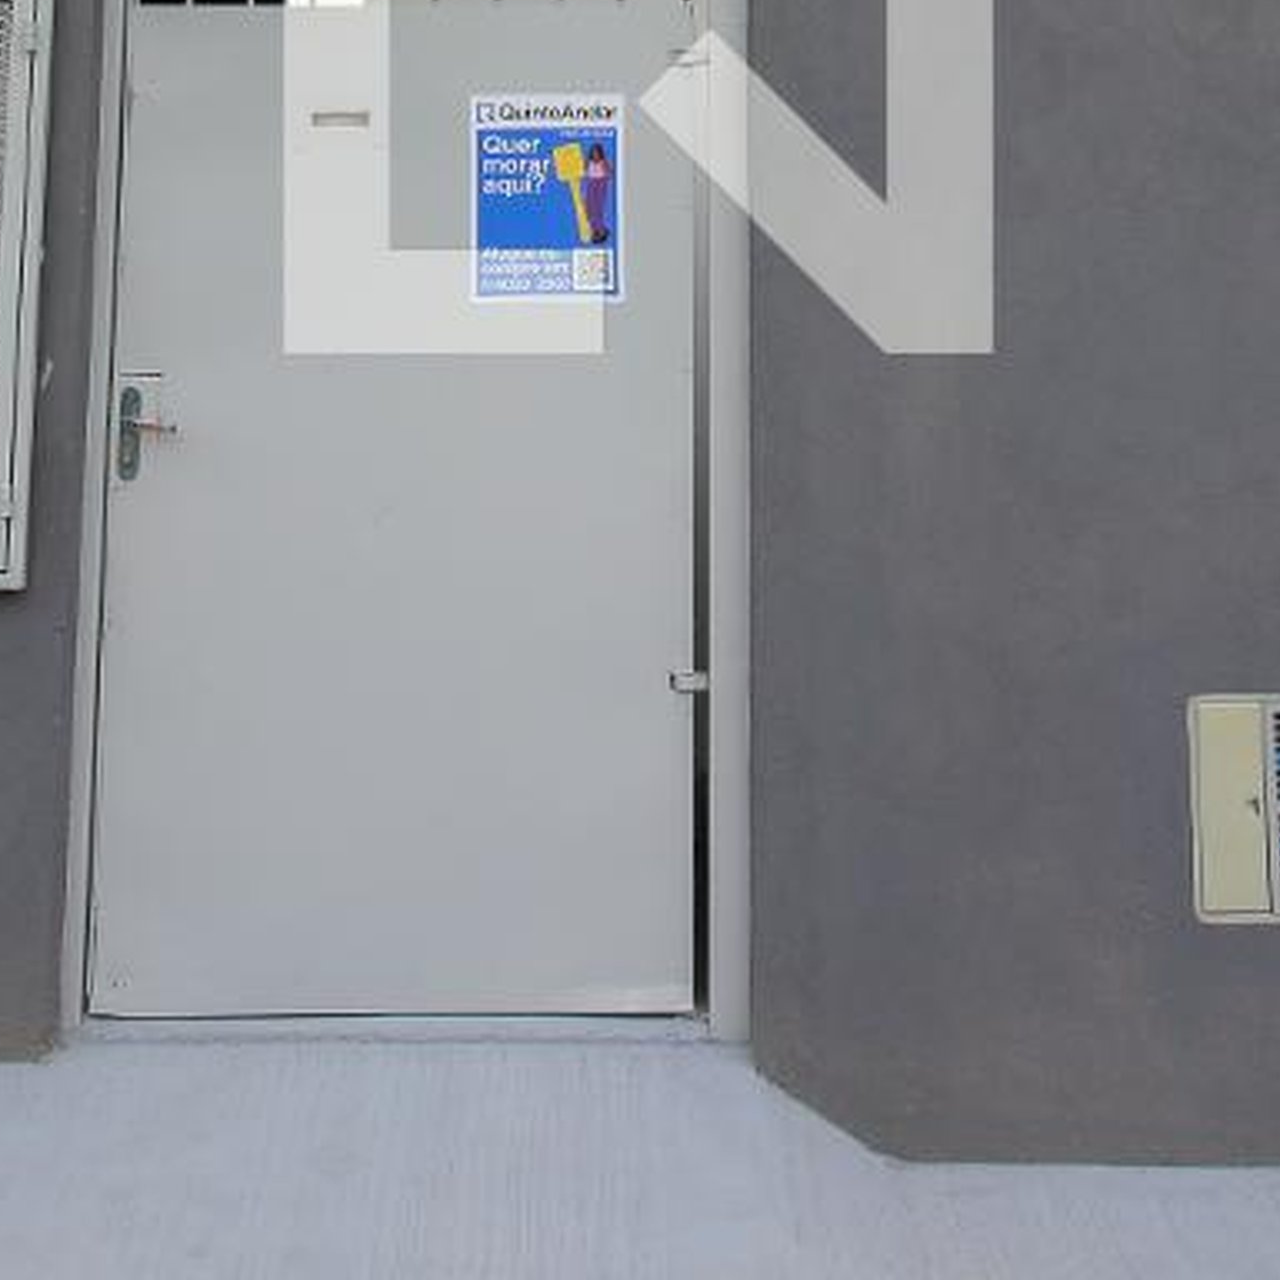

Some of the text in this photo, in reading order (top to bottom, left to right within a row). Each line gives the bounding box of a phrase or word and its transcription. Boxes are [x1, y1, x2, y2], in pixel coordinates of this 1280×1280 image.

[499, 102, 616, 121] QuintoAndar
[482, 135, 541, 155] Quer
[482, 158, 550, 175] morar
[482, 173, 545, 198] aqui?
